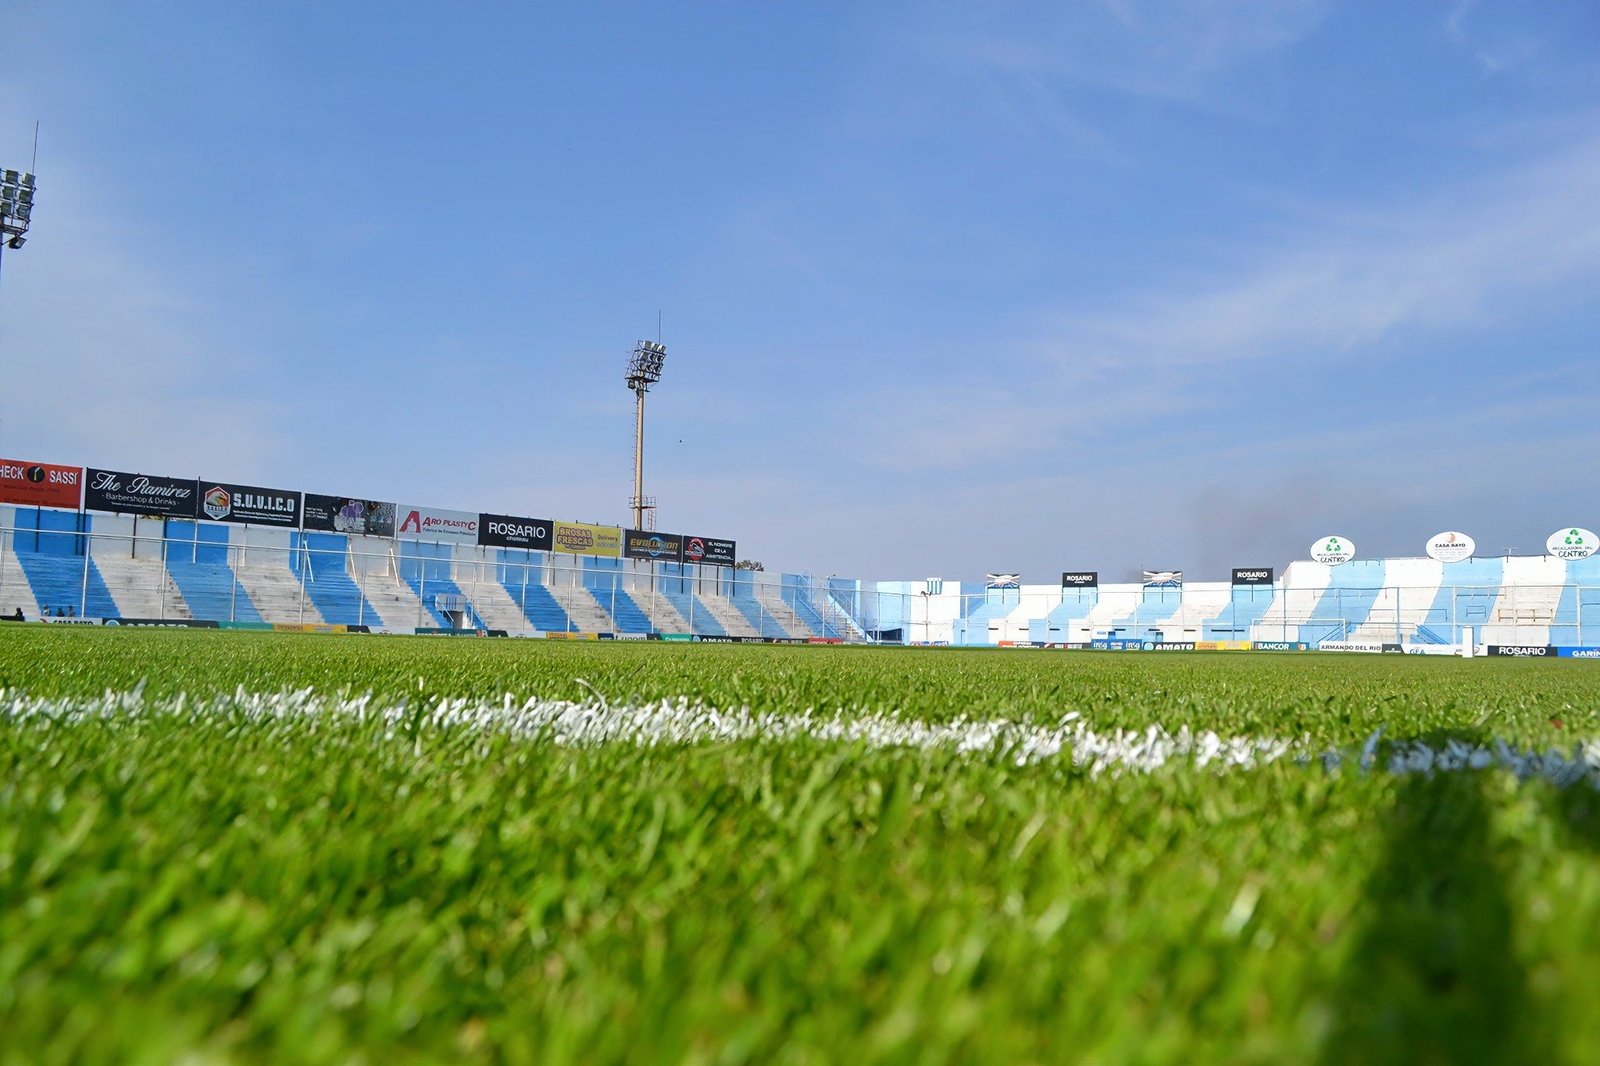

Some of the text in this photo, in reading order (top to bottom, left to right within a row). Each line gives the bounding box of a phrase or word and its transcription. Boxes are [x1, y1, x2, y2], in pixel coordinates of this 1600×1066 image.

[91, 472, 191, 498] The Ramirez
[105, 492, 147, 504] Barbershop
[488, 522, 546, 539] ROSARIO
[1155, 643, 1194, 651] AMATO
[1258, 642, 1290, 650] BANCOR
[1498, 646, 1547, 656] ROSARIO
